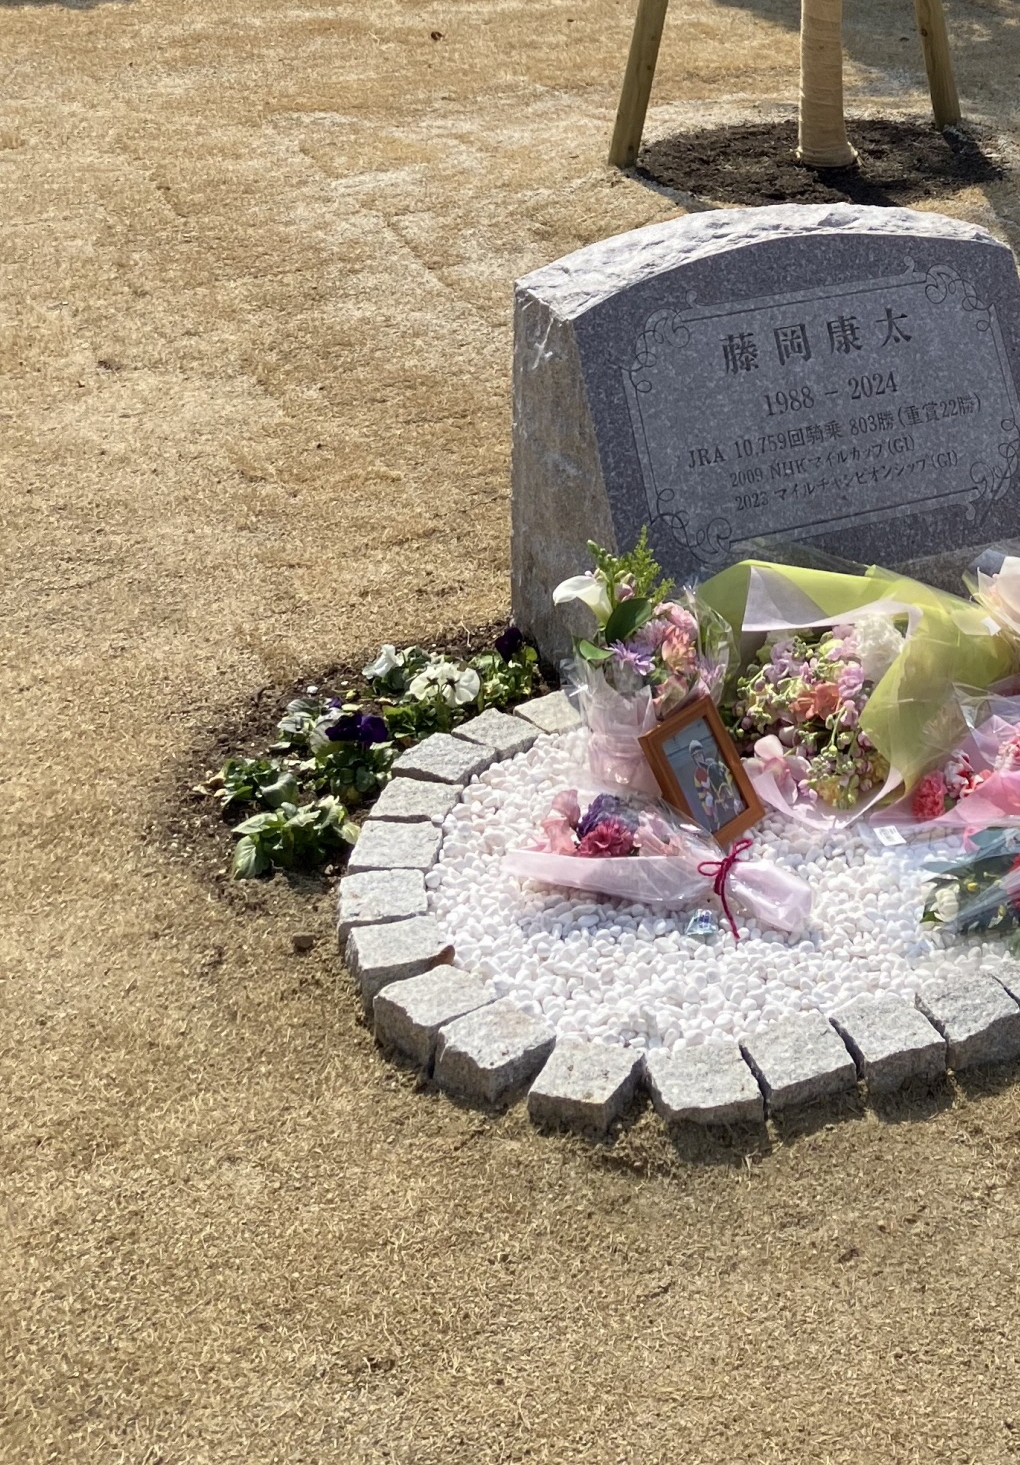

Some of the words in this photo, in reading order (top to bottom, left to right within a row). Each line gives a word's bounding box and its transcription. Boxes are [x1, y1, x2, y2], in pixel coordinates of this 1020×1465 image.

[721, 307, 913, 375] 藤岡康太
[763, 386, 815, 417] 1988
[847, 371, 899, 403] 2024
[688, 445, 727, 469] JRA
[734, 420, 844, 459] 10,759回騎乗
[729, 467, 764, 488] 2009
[735, 490, 769, 512] 2023
